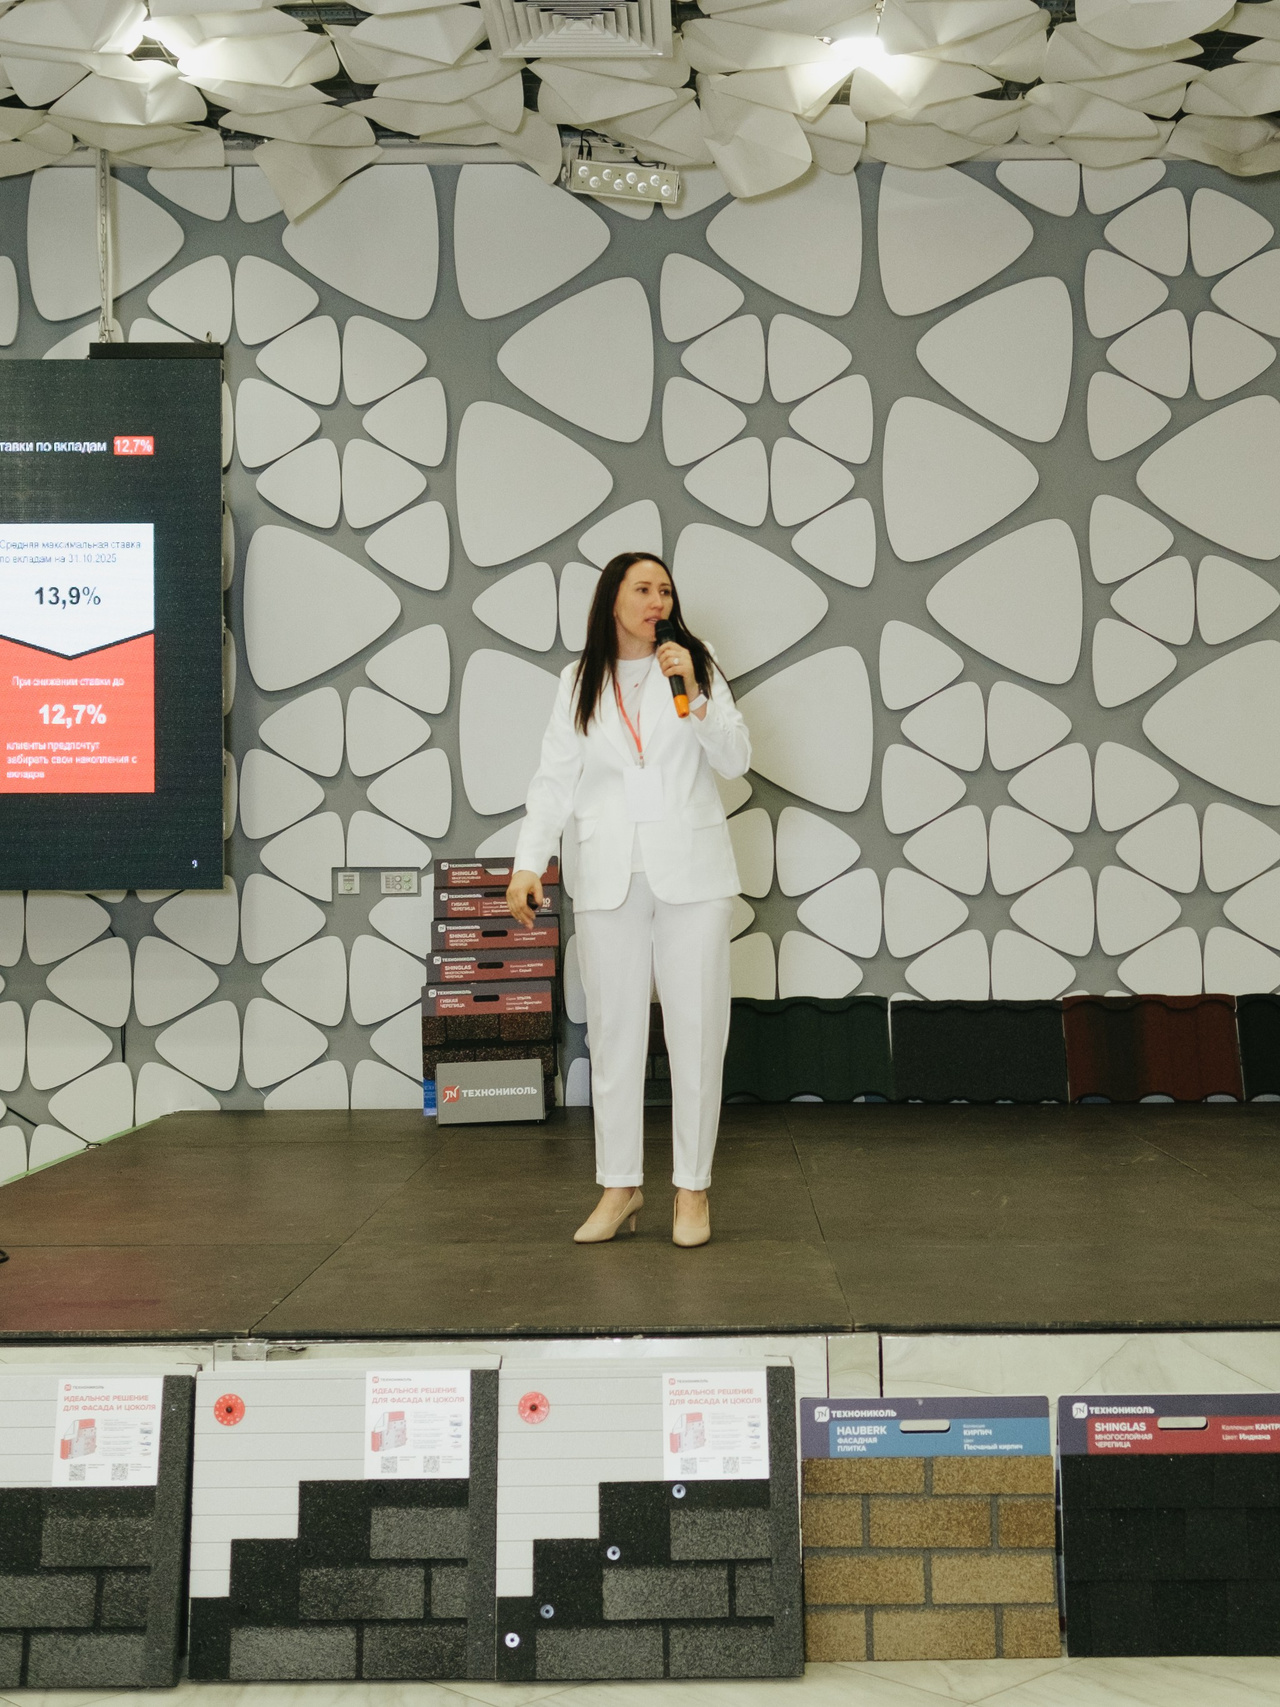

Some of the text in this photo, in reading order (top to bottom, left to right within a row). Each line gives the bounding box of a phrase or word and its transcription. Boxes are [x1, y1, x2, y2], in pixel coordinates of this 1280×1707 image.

[36, 441, 52, 452] по
[54, 441, 107, 453] вкладам
[115, 439, 152, 453] 12,7%
[35, 586, 101, 609] 13,9%
[12, 676, 31, 688] При
[112, 677, 125, 687] до
[39, 704, 106, 728] 12,7%
[6, 742, 46, 750] клиенты
[51, 756, 73, 764] свои
[131, 756, 137, 764] с
[462, 1087, 537, 1097] ТЕХНОНИКОЛЬ
[831, 1409, 897, 1419] ТЕХНОНИКОЛЬ
[1089, 1406, 1155, 1414] ТЕХНОНИКОЛЬ
[837, 1425, 887, 1436] HAUBERK
[1095, 1422, 1146, 1431] SHINGLAS
